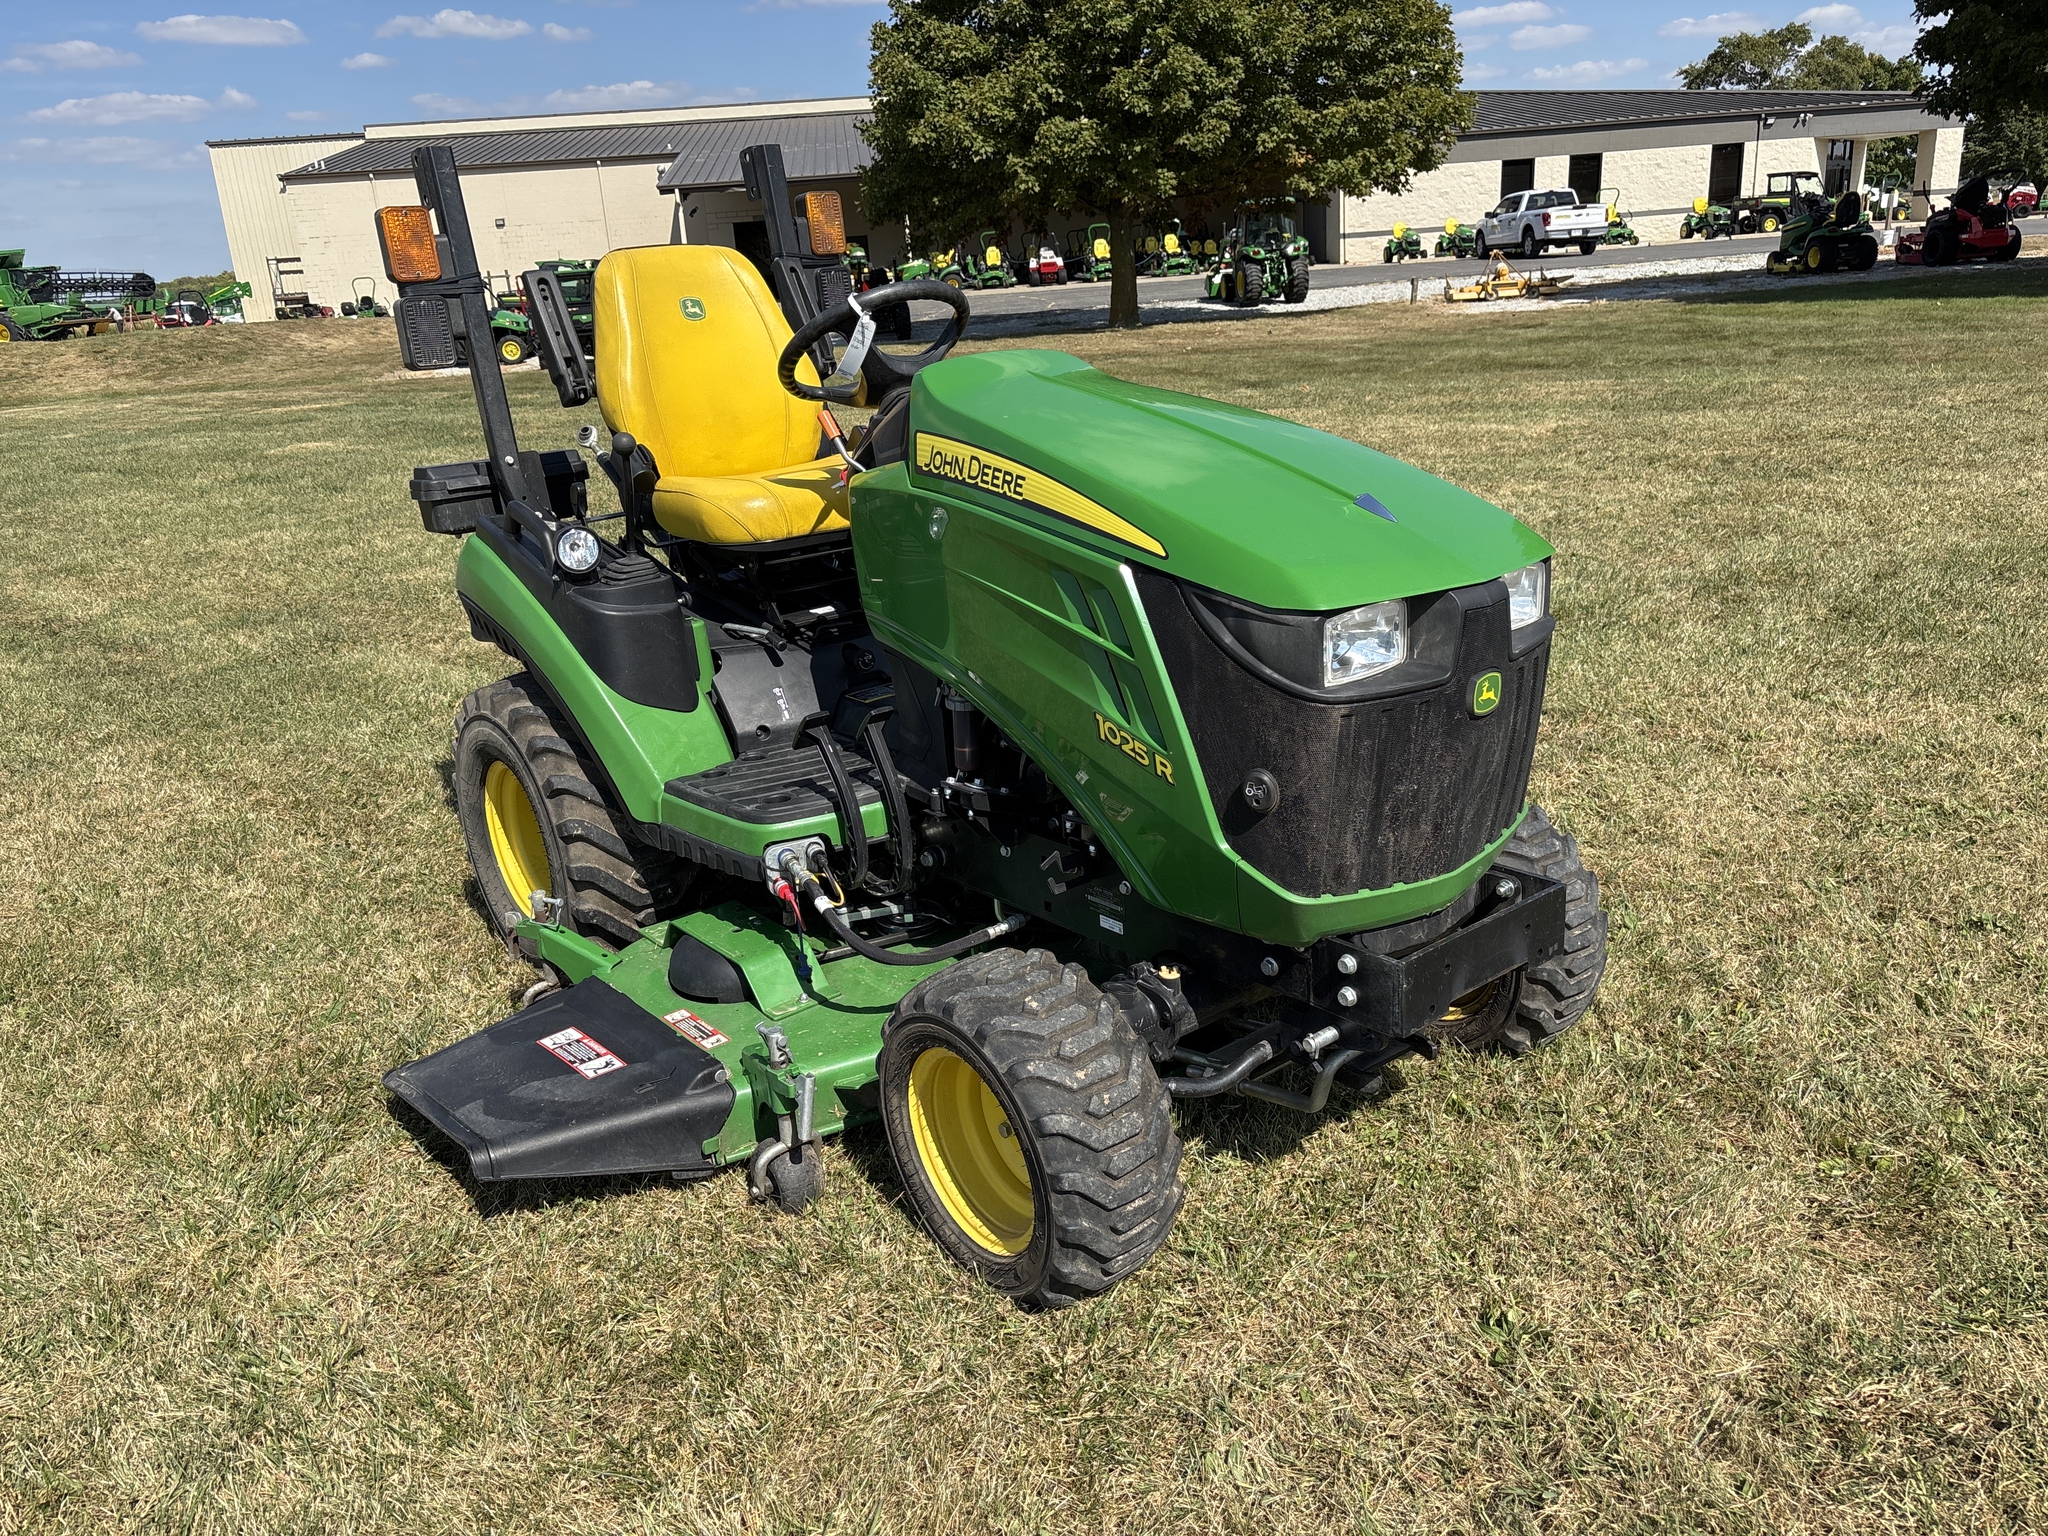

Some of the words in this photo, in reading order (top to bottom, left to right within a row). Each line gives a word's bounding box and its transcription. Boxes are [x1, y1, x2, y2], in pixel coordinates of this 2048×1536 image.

[923, 444, 965, 477] JOHN
[967, 454, 1026, 498] DEERE
[1094, 711, 1150, 767] 1025
[1153, 751, 1175, 786] R
